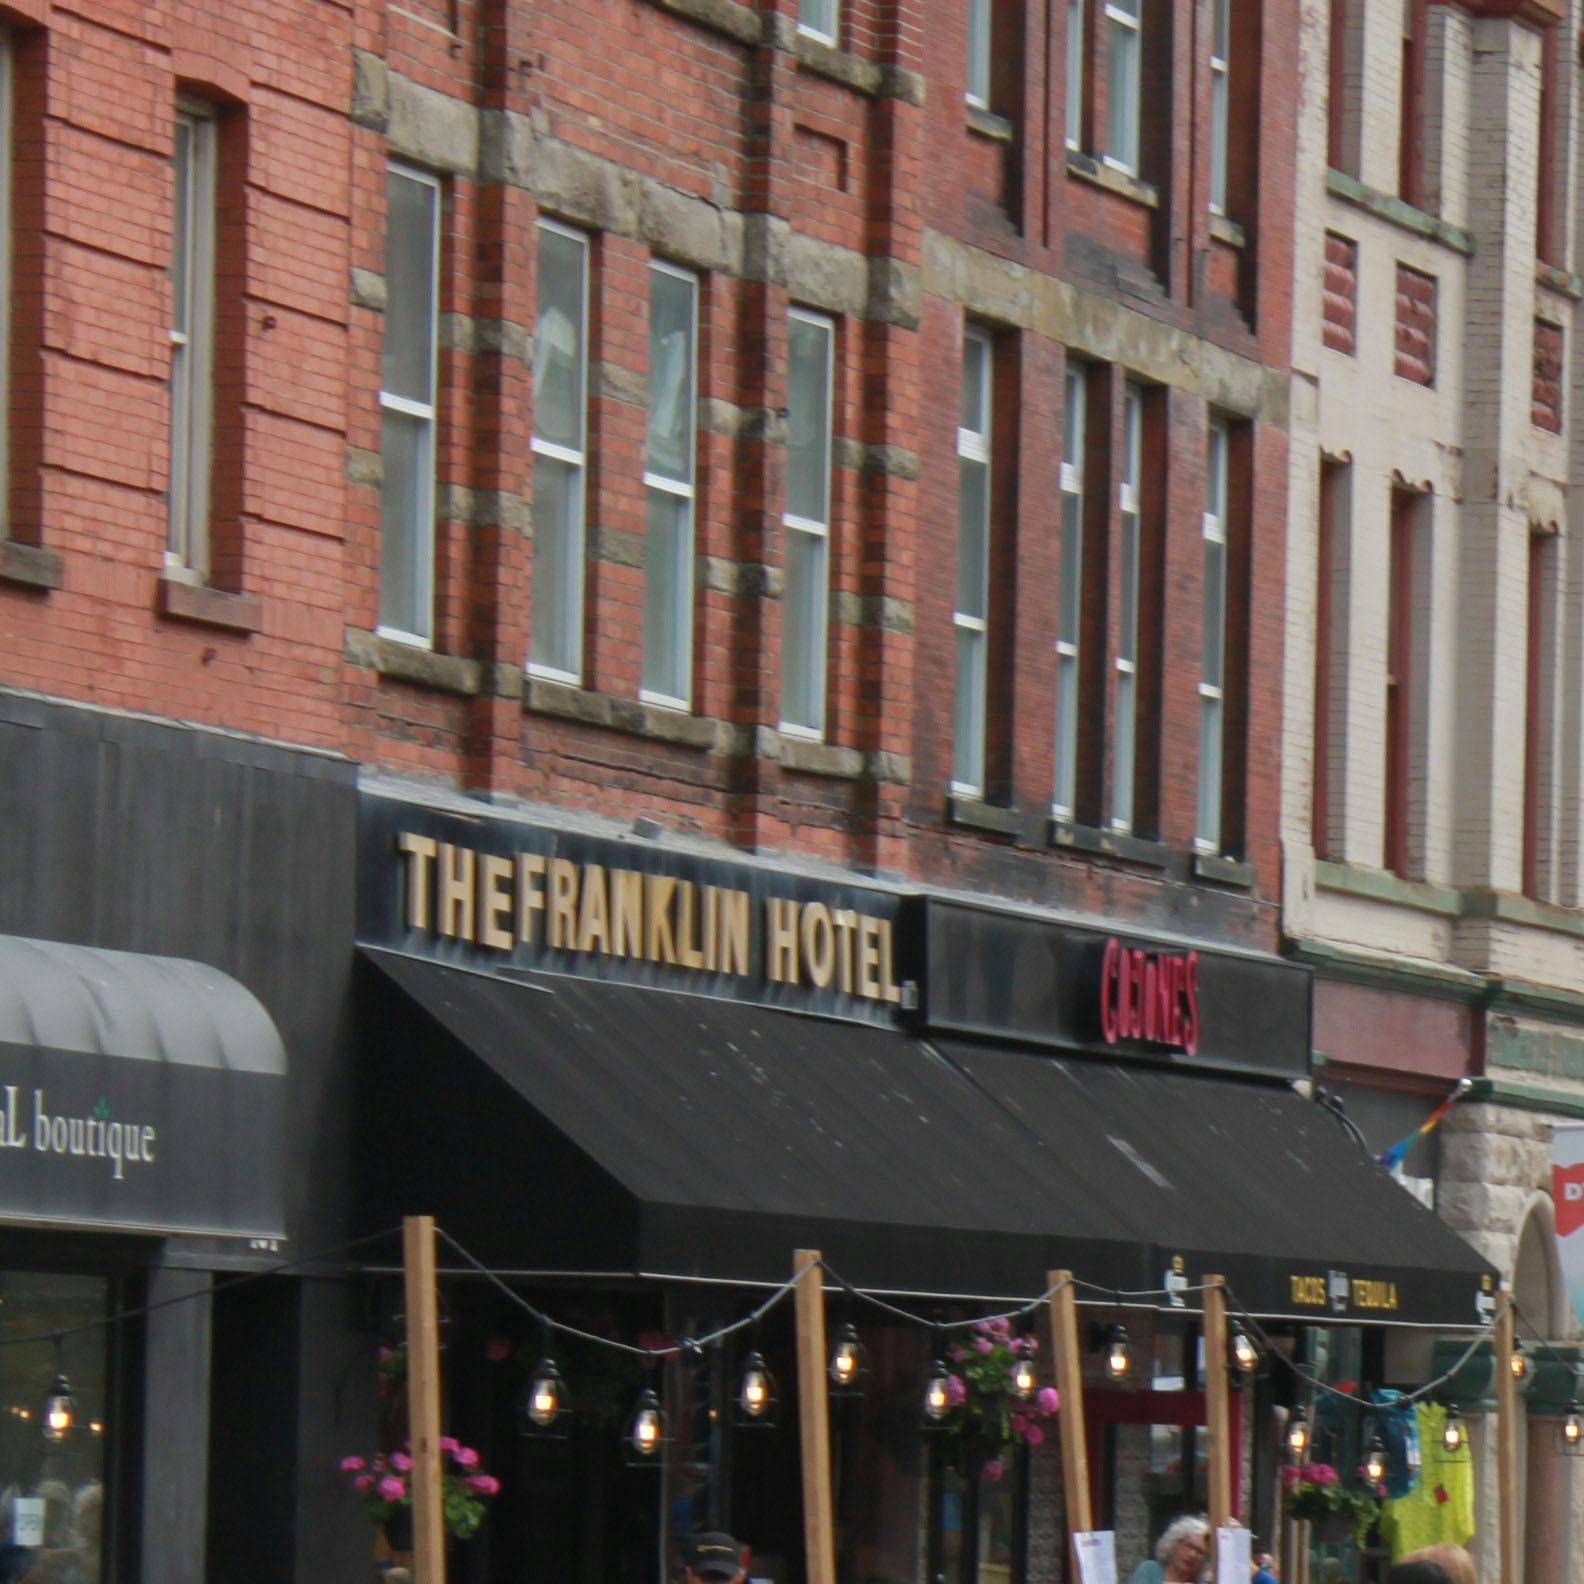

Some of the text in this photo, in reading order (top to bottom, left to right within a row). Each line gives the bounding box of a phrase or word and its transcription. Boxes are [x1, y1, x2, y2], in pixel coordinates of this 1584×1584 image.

[767, 896, 901, 1003] HOTEL
[34, 1088, 156, 1180] boutique
[1289, 1274, 1327, 1305] TACOS
[1351, 1278, 1398, 1310] TEQUILA
